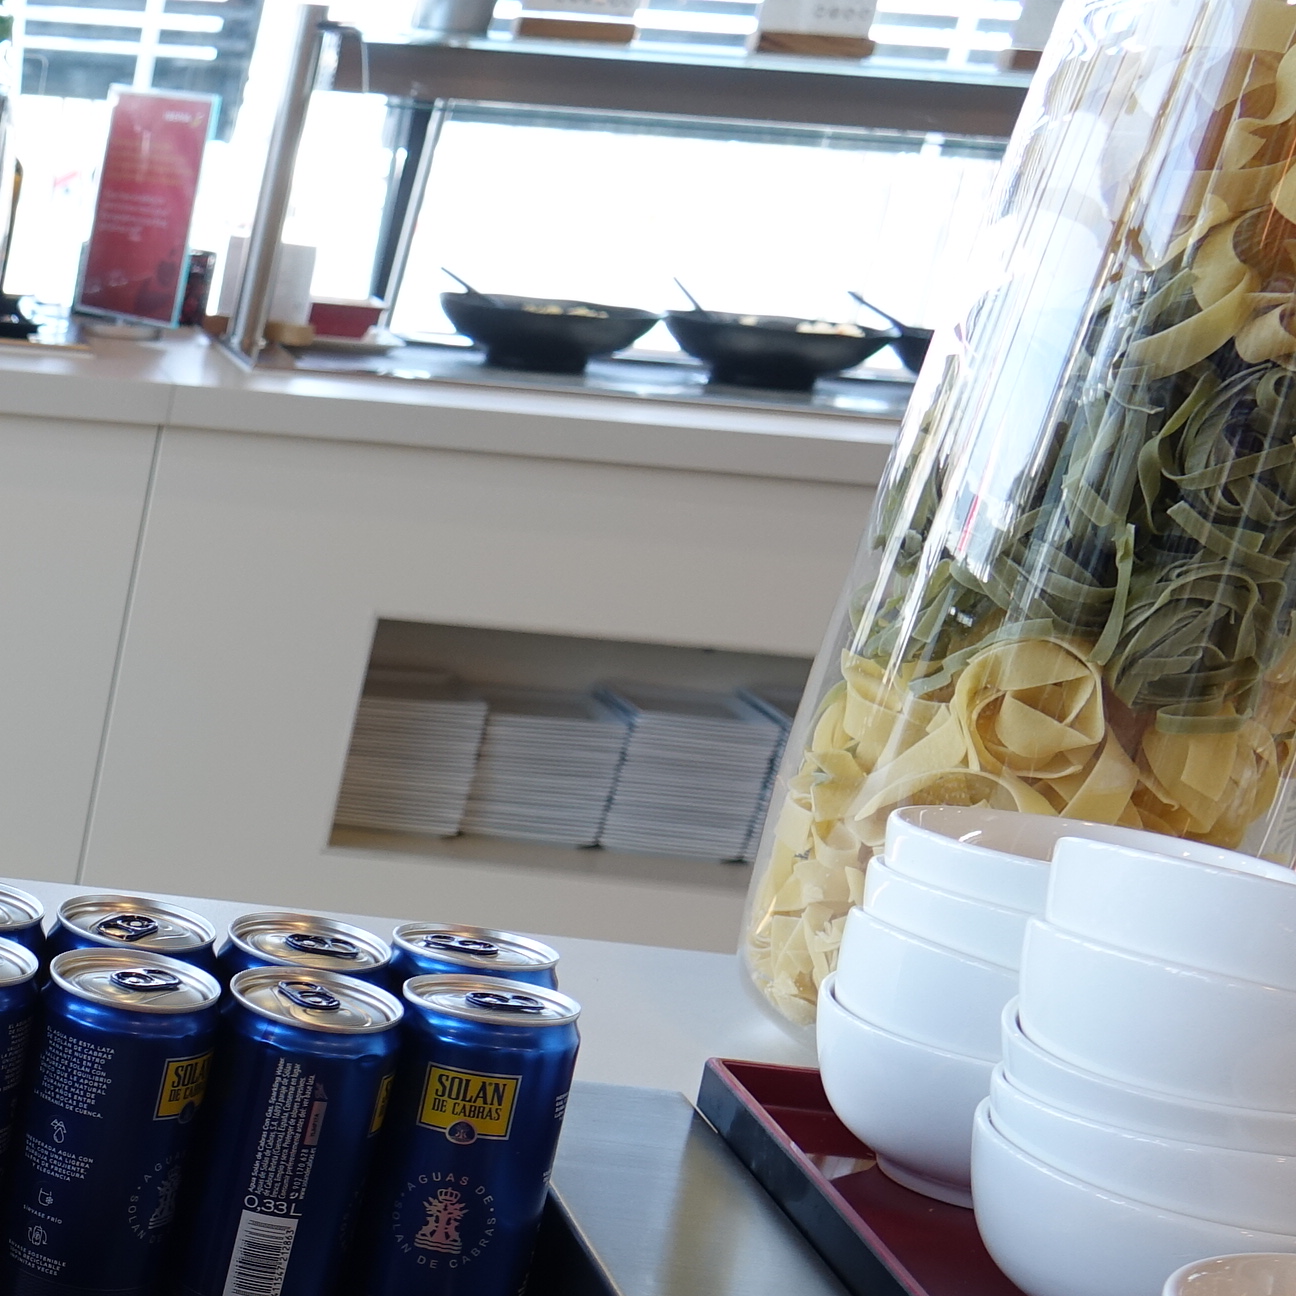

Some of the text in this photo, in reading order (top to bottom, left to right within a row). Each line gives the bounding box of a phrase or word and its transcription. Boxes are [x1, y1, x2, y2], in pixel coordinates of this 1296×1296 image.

[78, 1039, 95, 1049] ESTA
[97, 1045, 115, 1054] LATA
[83, 1047, 112, 1060] CABRAS
[74, 1050, 106, 1064] NUESTRO
[72, 1068, 112, 1084] EQUILIBRIO
[91, 1069, 106, 1077] CON
[73, 1082, 106, 1095] NATURAL
[79, 1077, 107, 1090] APORTA
[73, 1094, 95, 1104] ENTRE
[168, 1088, 181, 1102] DE
[432, 1096, 501, 1122] DE CABRAS
[57, 1149, 93, 1164] AGUA CON
[64, 1157, 90, 1169] LIGERA
[35, 1164, 72, 1181] ELEGANCIA
[49, 1164, 85, 1179] FRESCURA
[406, 1171, 469, 1192] AGUAS
[474, 1185, 495, 1205] DE
[244, 1194, 303, 1217] 0,33 L
[278, 1228, 295, 1261] 212863
[449, 1216, 497, 1269] CABRAS
[21, 1253, 61, 1271] RECICLABLE
[27, 1249, 66, 1267] SOSTENIBLE
[416, 1254, 438, 1269] DE
[34, 1264, 58, 1276] VECES
